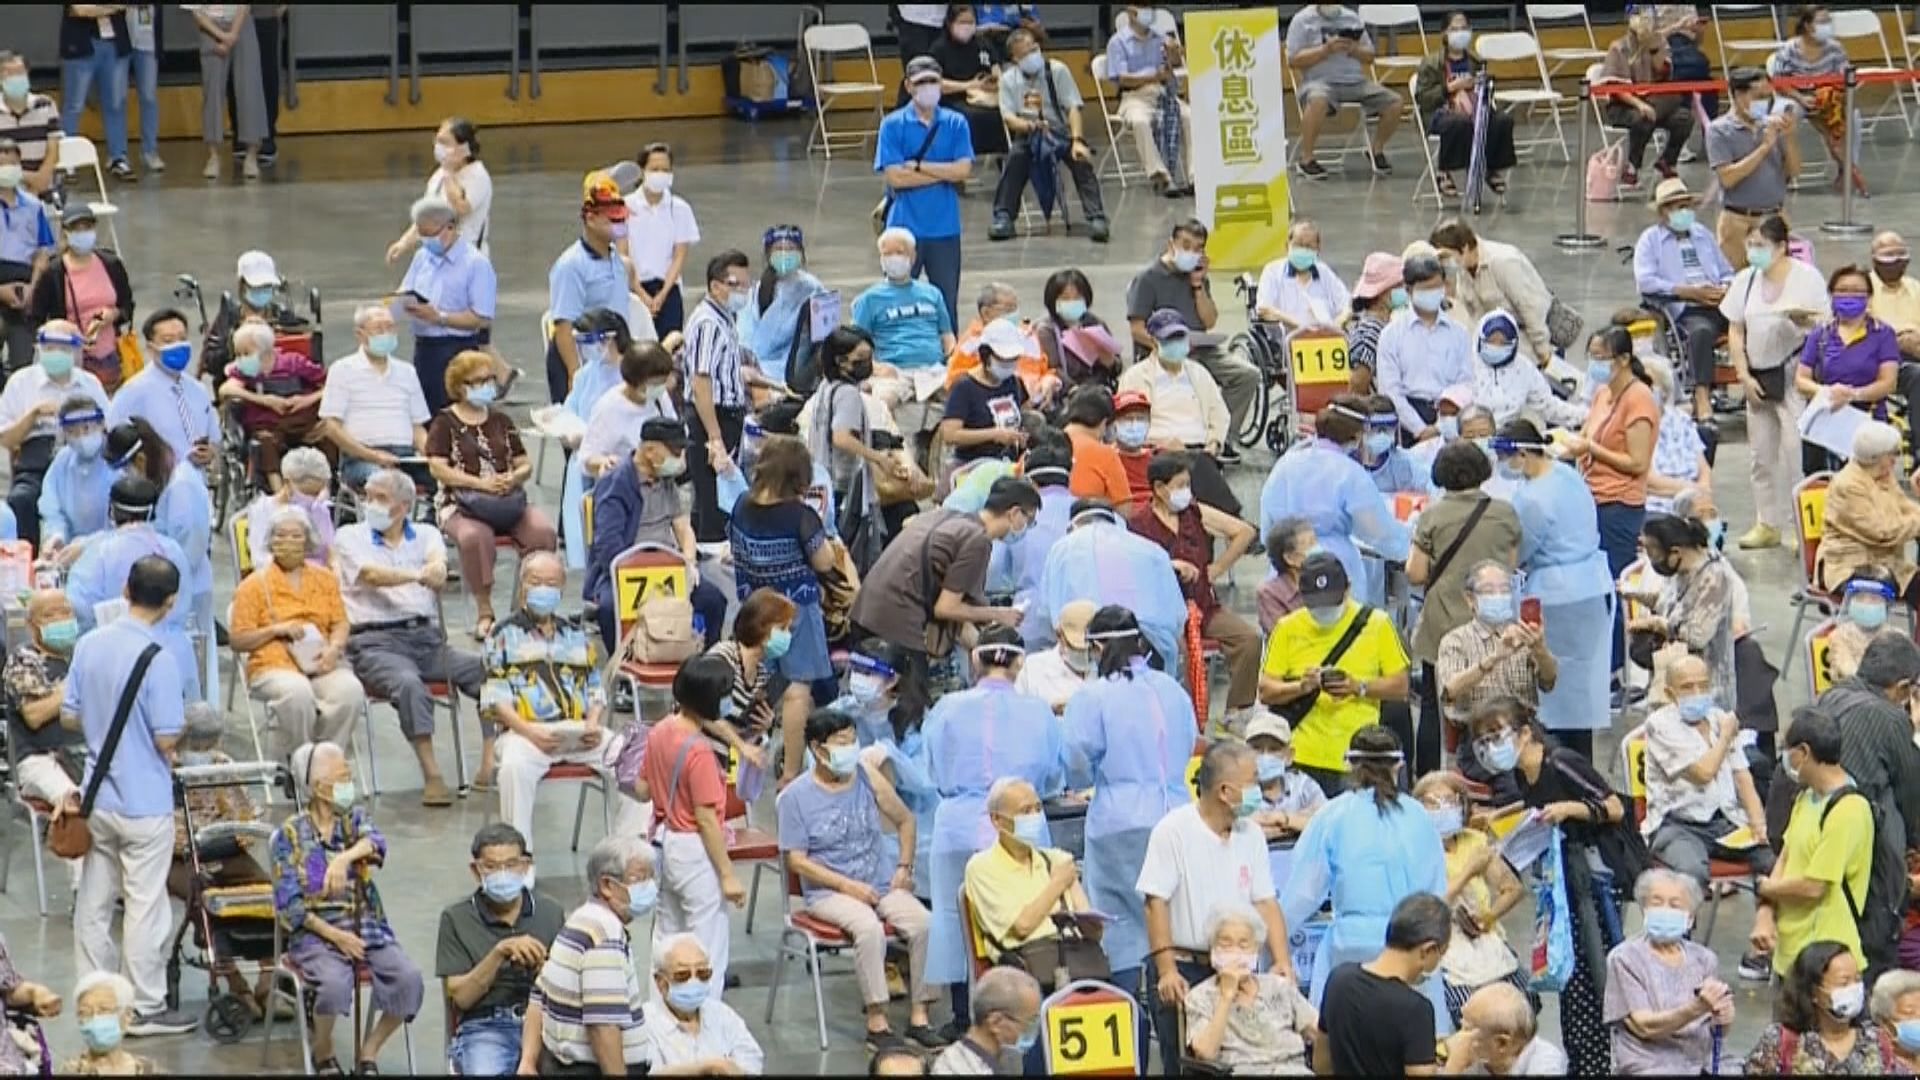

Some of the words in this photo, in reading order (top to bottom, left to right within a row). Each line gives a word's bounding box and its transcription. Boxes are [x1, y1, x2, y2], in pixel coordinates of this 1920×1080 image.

[1212, 28, 1261, 165] 休息區
[1296, 348, 1345, 373] 119
[1059, 1013, 1121, 1061] 51
